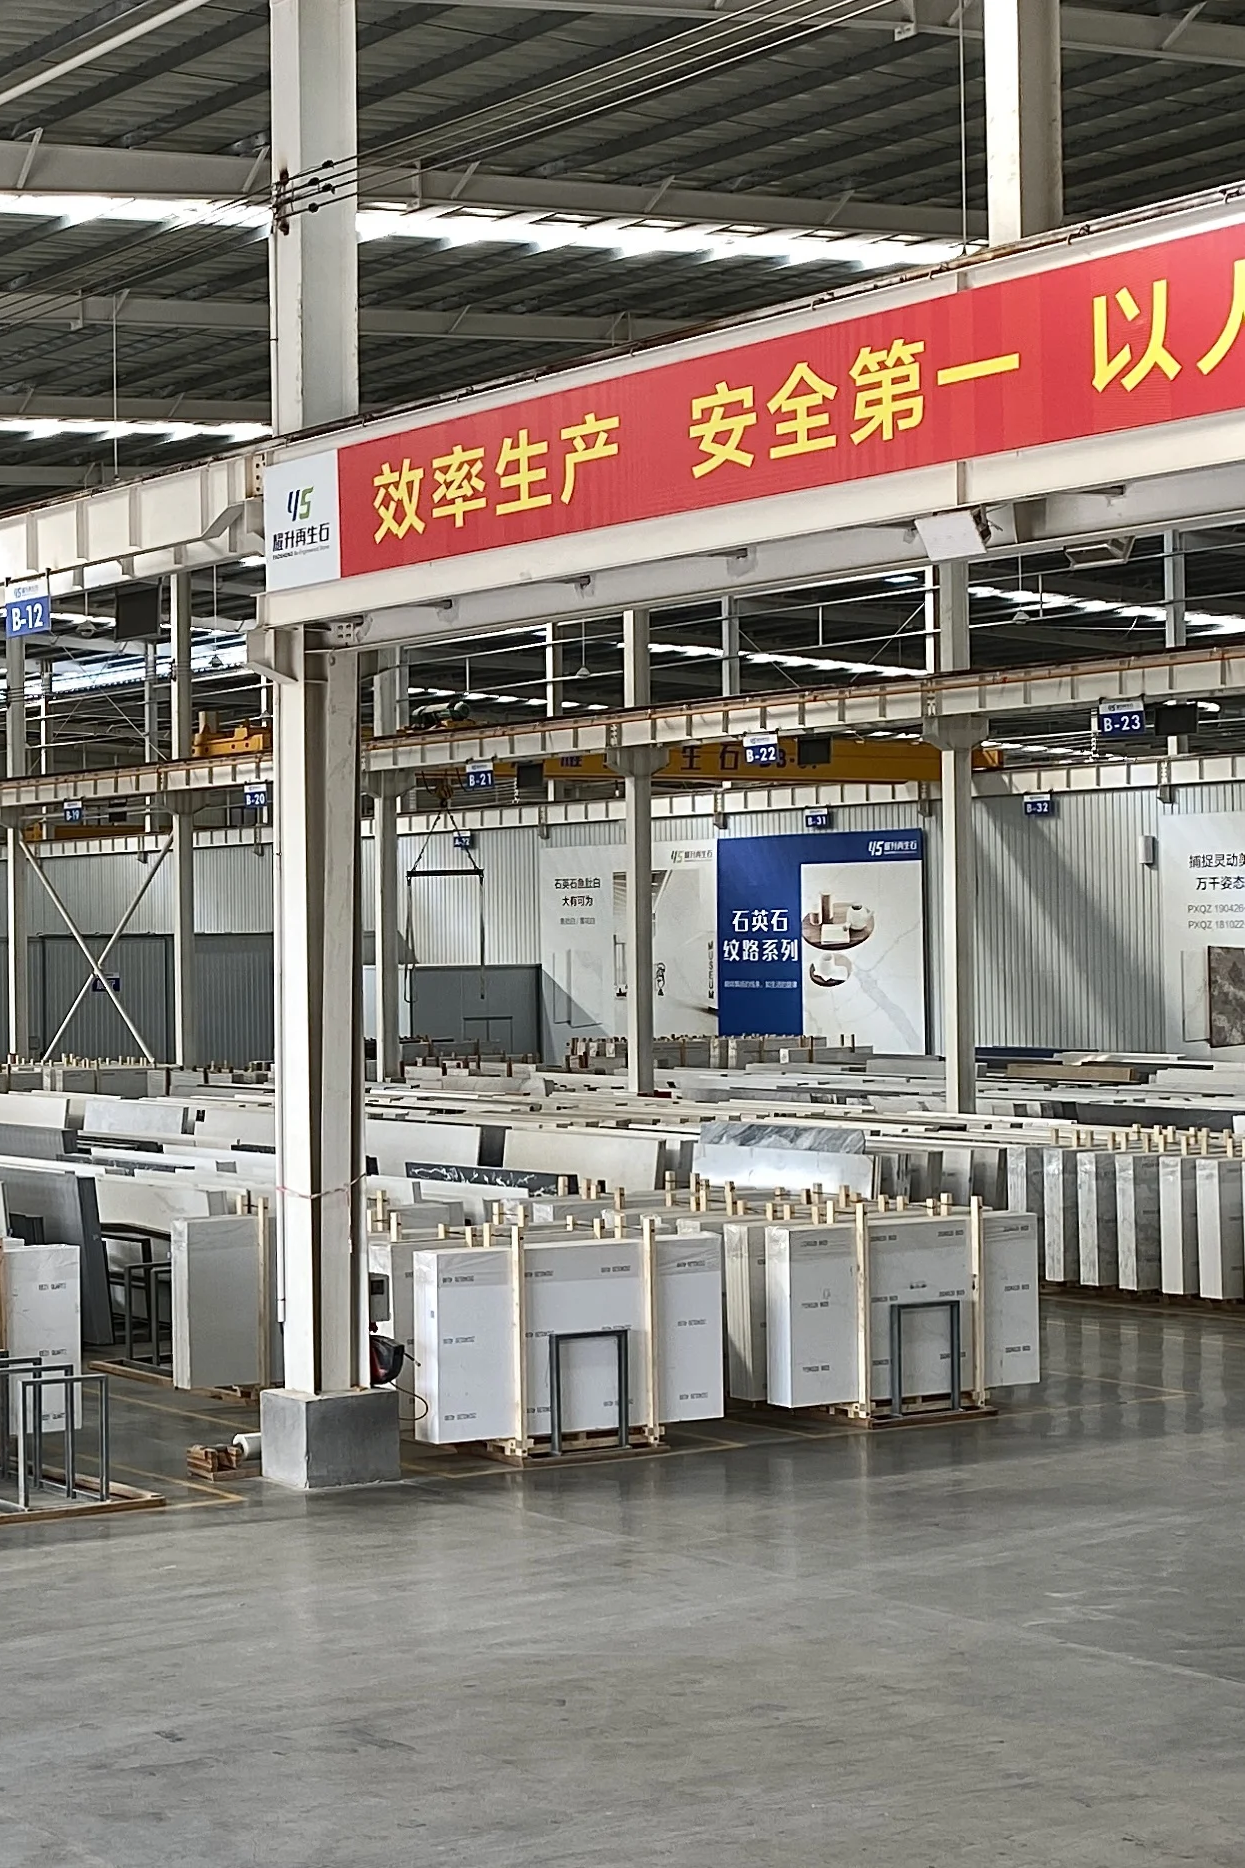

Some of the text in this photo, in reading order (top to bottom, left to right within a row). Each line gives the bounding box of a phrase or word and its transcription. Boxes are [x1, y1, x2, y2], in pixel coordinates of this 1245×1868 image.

[373, 413, 619, 544] 效率生产
[689, 338, 1020, 479] 安全第一
[12, 603, 43, 632] B-12
[1104, 715, 1140, 731] B-23
[746, 747, 776, 763] B-22
[469, 773, 492, 787] B-21
[246, 793, 265, 805] B-20
[1026, 802, 1048, 813] B-32
[807, 816, 826, 826] B-31
[1195, 876, 1245, 890] 万千姿态
[562, 895, 593, 907] 大有可为
[731, 908, 789, 933] 石英石
[722, 938, 799, 962] 纹路系列
